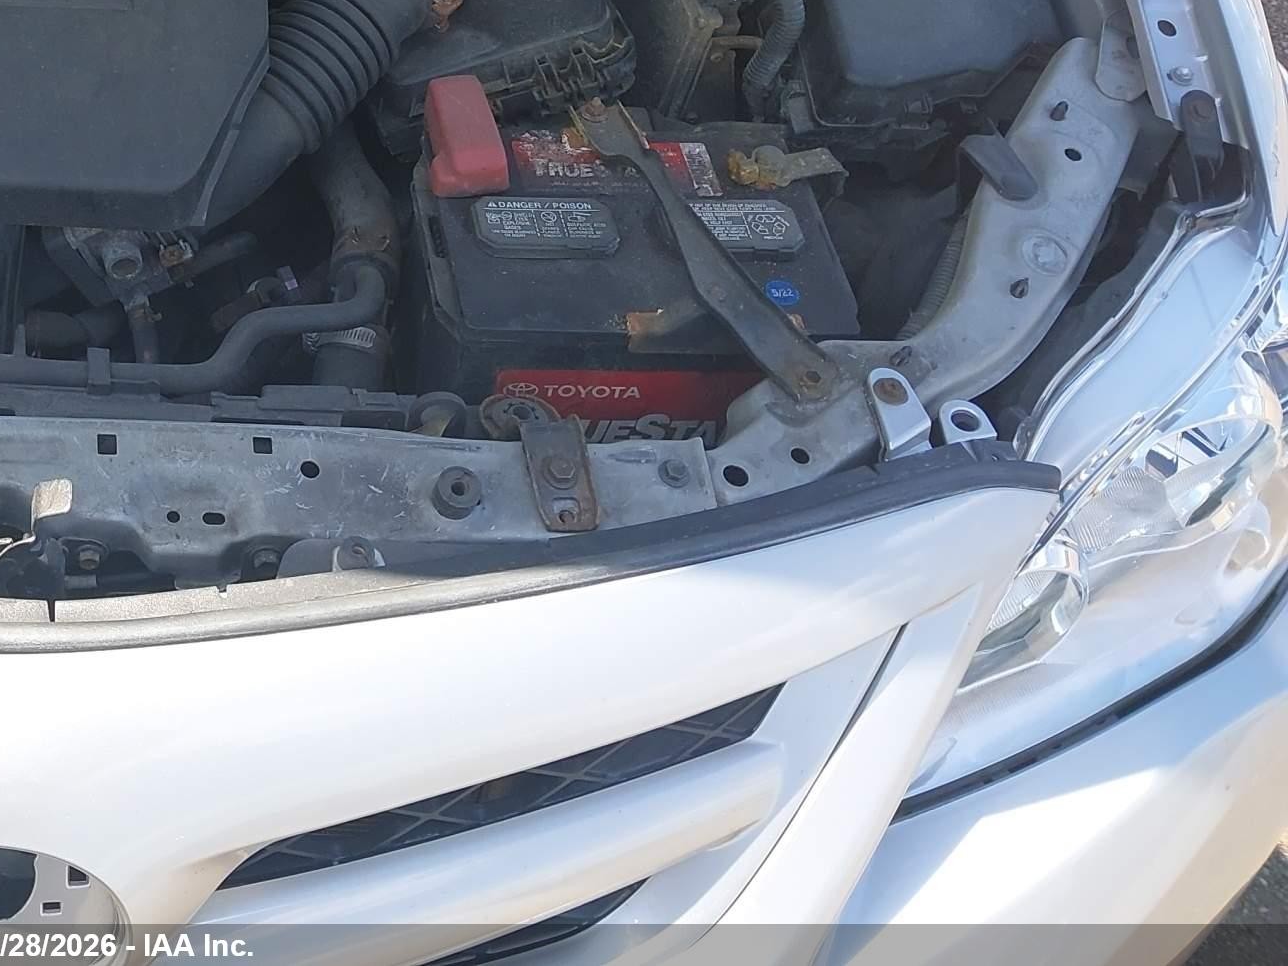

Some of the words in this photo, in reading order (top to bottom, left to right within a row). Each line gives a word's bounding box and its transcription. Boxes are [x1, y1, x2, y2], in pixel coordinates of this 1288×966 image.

[498, 201, 542, 210] DANGER
[552, 201, 592, 210] POISON
[544, 385, 641, 399] TOYOTA
